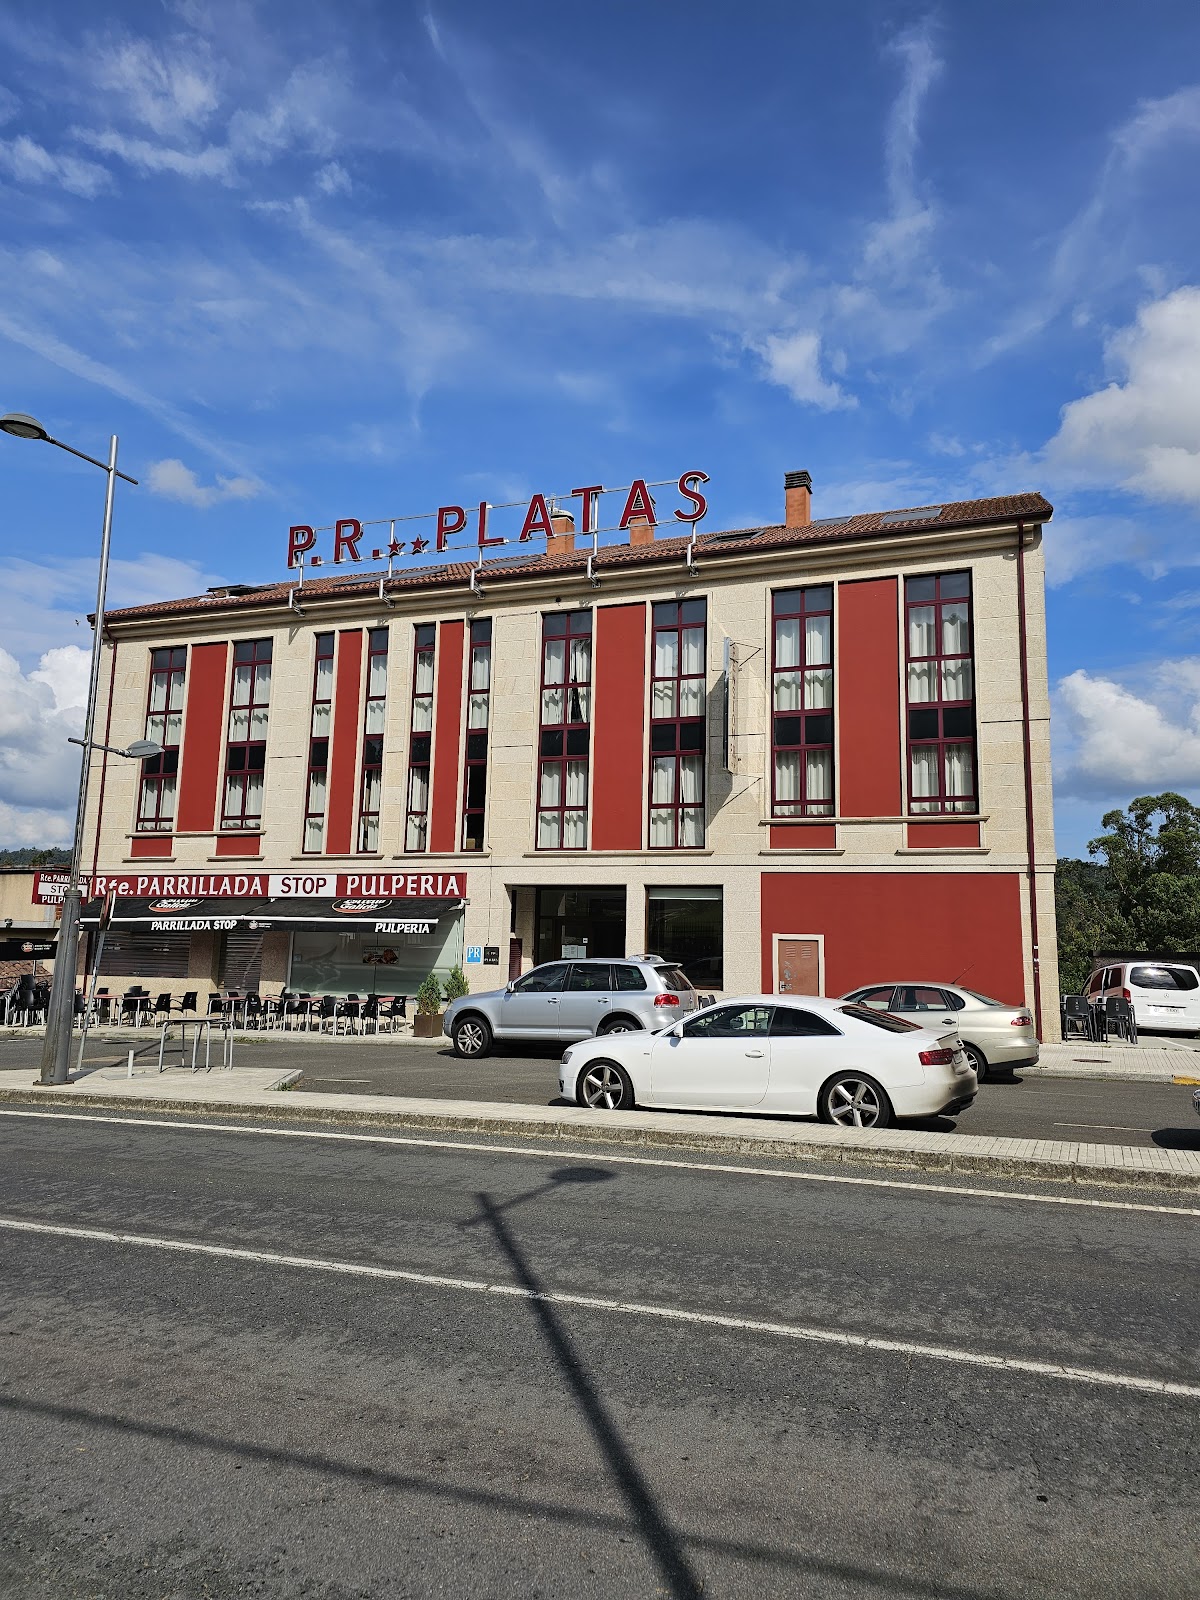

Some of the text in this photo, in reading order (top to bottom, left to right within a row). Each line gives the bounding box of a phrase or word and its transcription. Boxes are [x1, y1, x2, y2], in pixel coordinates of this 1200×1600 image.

[287, 470, 711, 570] P.R. PLATAS
[52, 874, 88, 884] PARRIDA
[50, 884, 69, 894] STO
[136, 876, 263, 896] PARRILLADA
[280, 876, 327, 895] STOP
[346, 875, 460, 896] PULPERIA
[150, 920, 237, 931] PARRILLADA STOP
[374, 922, 430, 934] PULPERIA
[467, 947, 480, 958] PR
